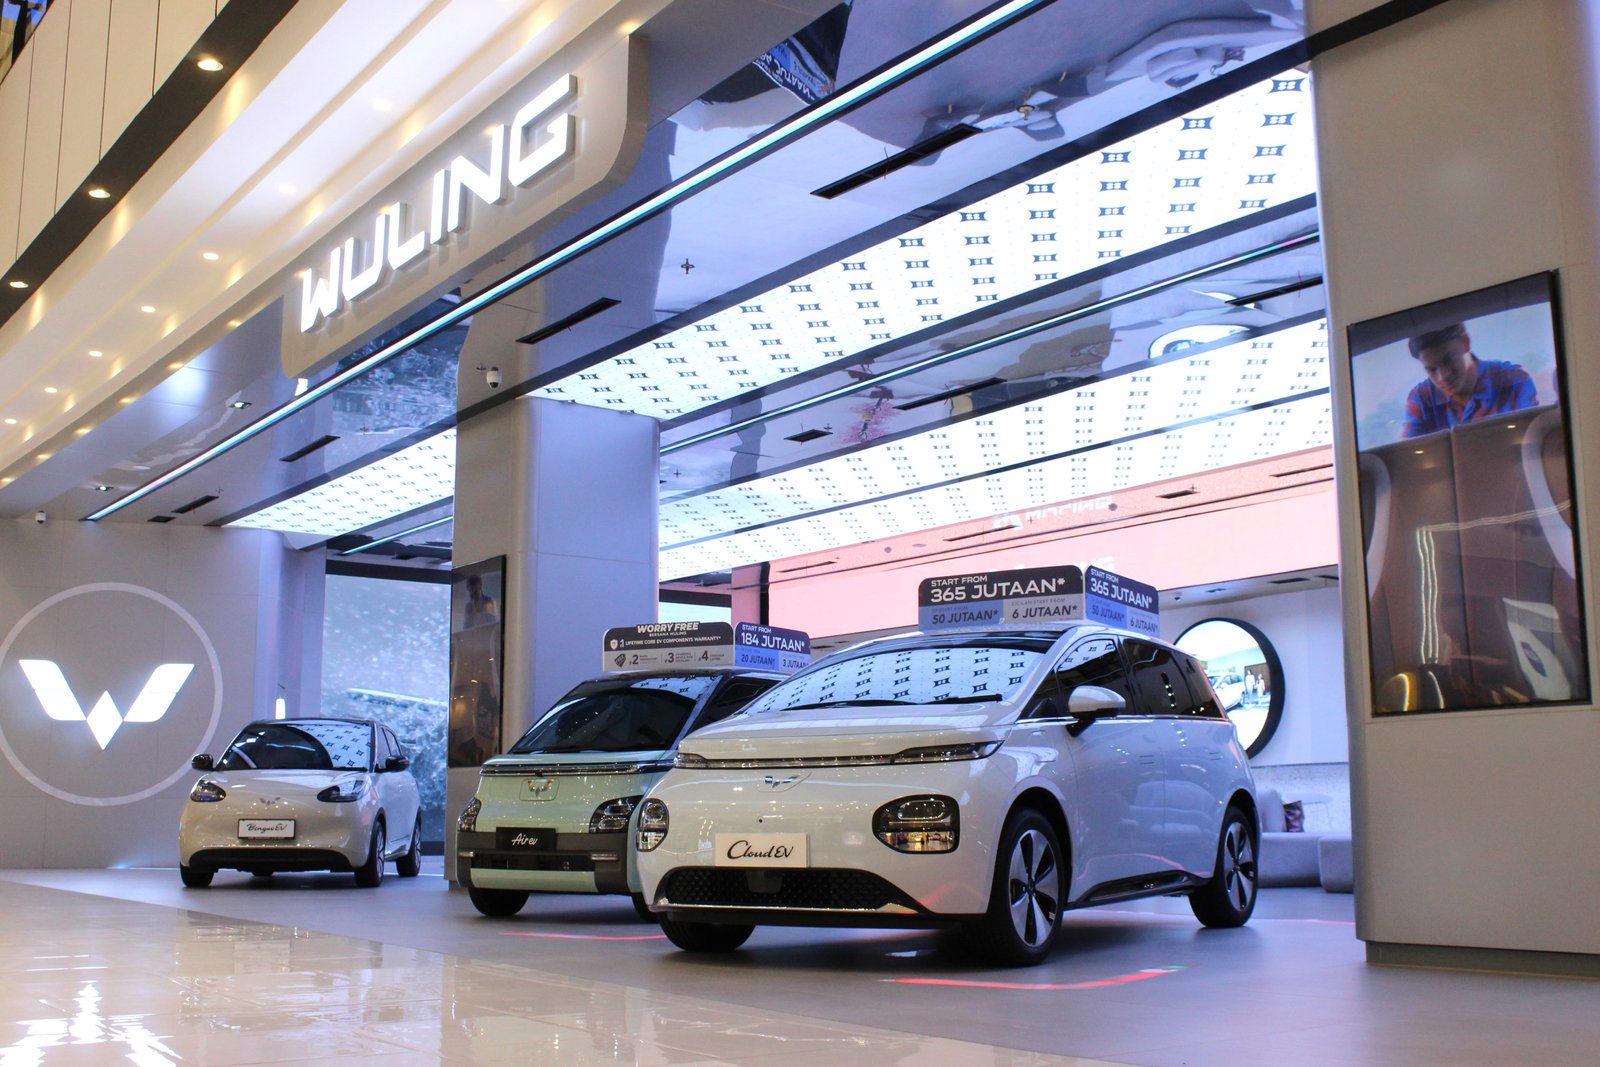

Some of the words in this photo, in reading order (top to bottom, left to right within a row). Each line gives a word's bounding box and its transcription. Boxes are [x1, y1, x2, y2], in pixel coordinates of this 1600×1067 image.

[300, 73, 576, 333] WULING
[930, 578, 959, 587] START
[961, 575, 988, 584] FROM
[1090, 568, 1105, 579] START
[1105, 573, 1119, 584] FROM
[1090, 578, 1110, 596] 365
[930, 586, 967, 603] 365
[1012, 608, 1019, 619] 6
[1092, 604, 1099, 615] 50
[932, 613, 945, 624] 50
[1130, 617, 1134, 627] 6
[637, 623, 674, 634] WORRY
[674, 622, 699, 632] FREE
[742, 624, 758, 632] START
[758, 626, 772, 634] FROM
[741, 632, 760, 646] 184
[741, 654, 749, 663] 20
[782, 659, 786, 668] 3
